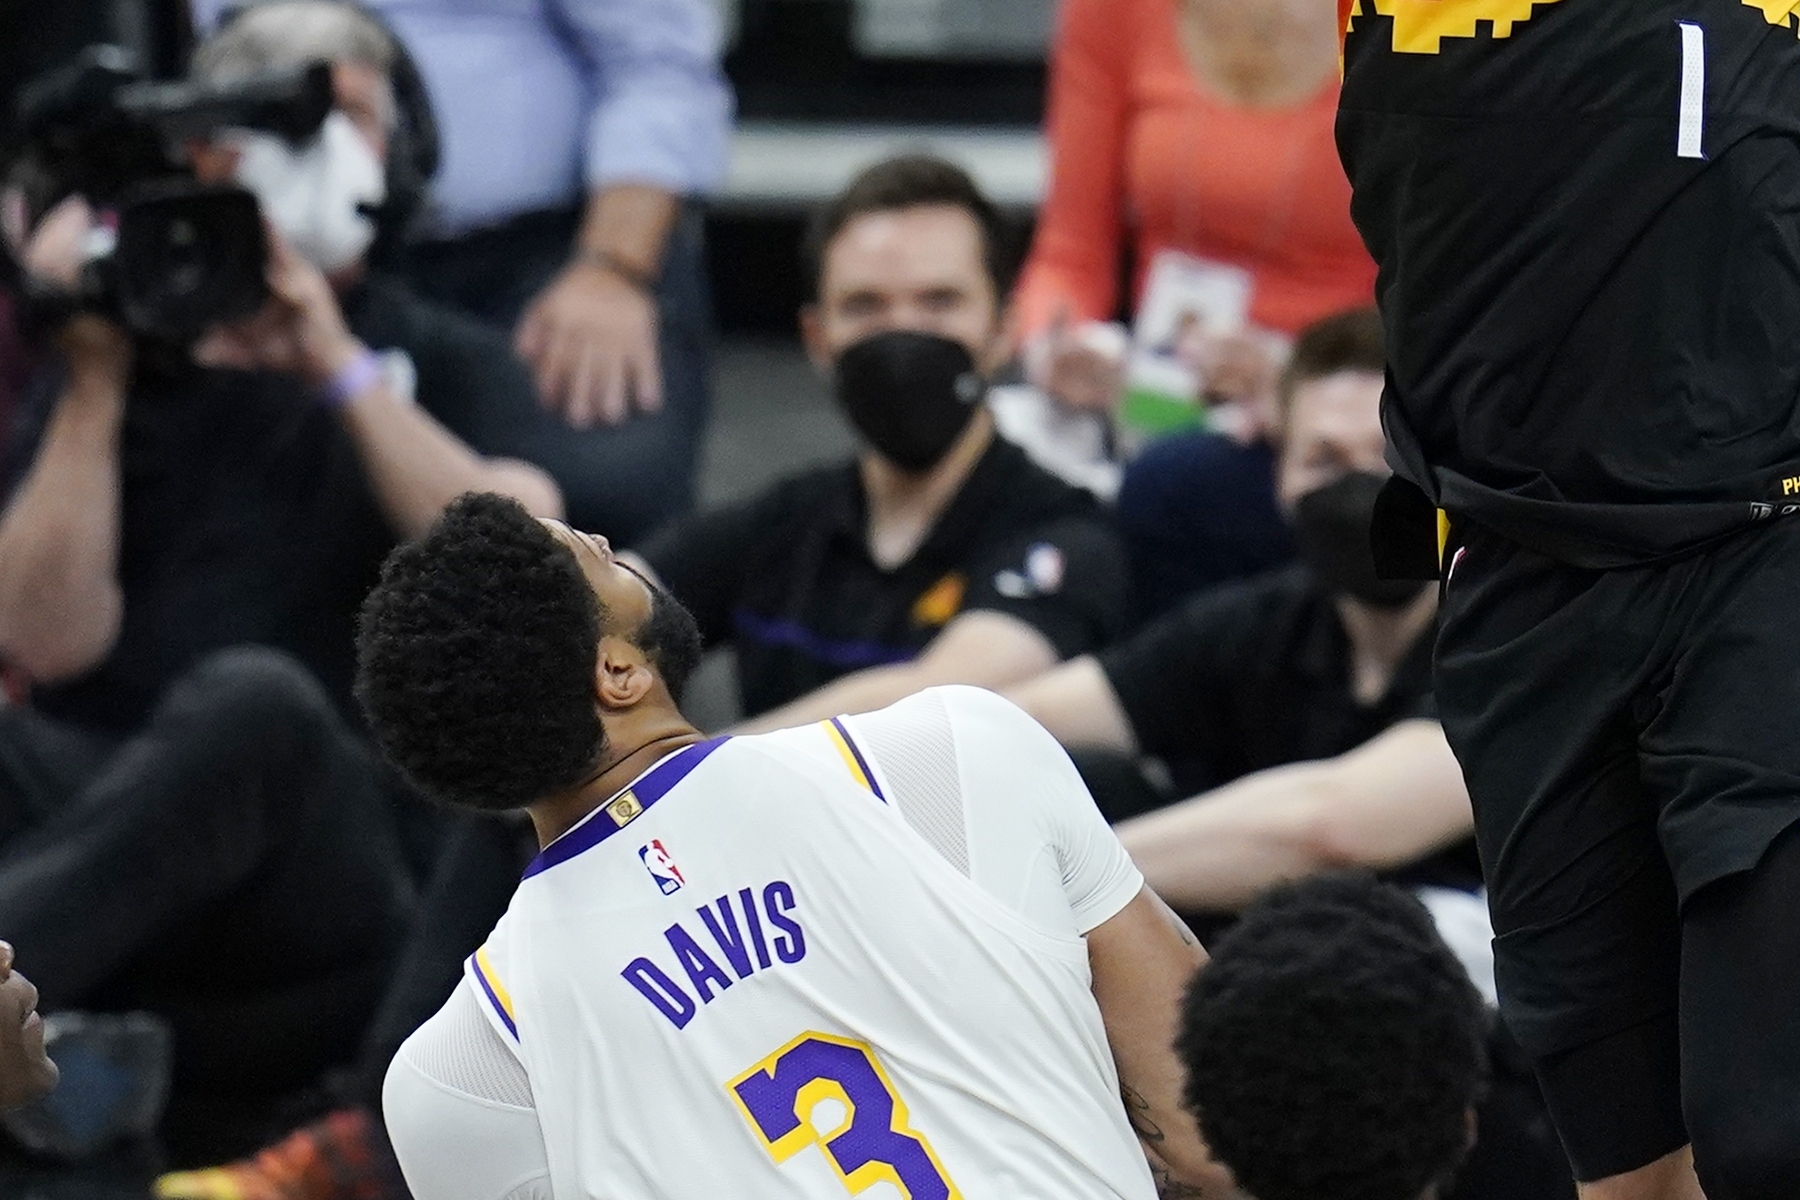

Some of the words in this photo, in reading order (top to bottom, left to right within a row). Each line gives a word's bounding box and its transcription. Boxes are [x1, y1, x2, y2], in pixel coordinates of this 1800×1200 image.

[1677, 22, 1705, 159] 1
[620, 880, 807, 1031] DAVIS
[723, 1029, 966, 1200] 3
